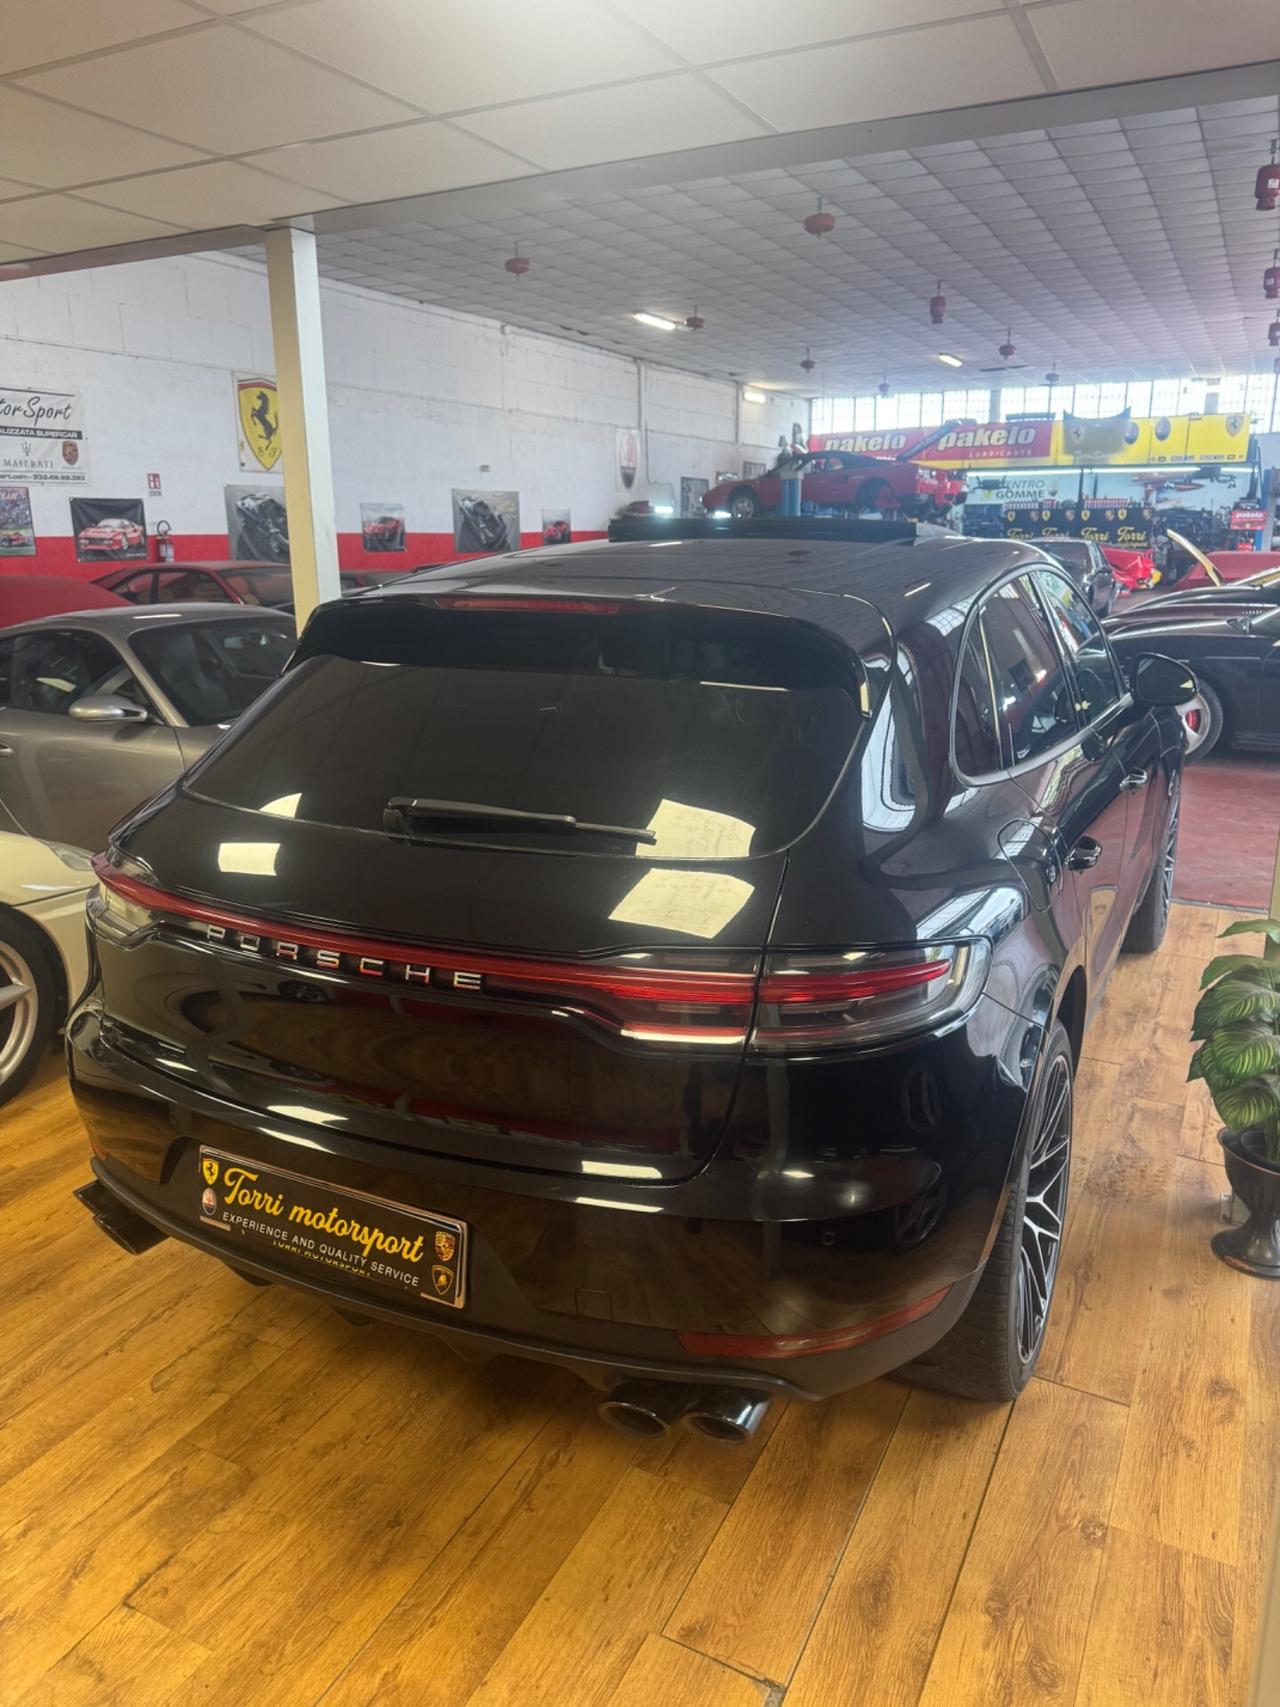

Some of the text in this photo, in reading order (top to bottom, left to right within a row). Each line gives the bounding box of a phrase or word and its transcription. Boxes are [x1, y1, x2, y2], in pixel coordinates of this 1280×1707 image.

[36, 430, 78, 439] SUPERCAR
[937, 425, 1038, 451] pakelo
[3, 458, 54, 468] MASERATI
[1003, 478, 1046, 489] ENTRO
[995, 490, 1044, 500] GOMME
[1081, 527, 1109, 541] Torri
[1117, 526, 1147, 542] Torri
[206, 923, 482, 990] PORSCHE
[223, 1167, 424, 1263] Torri motorsport
[222, 1211, 420, 1288] EXPERIENCE AND QUALITY SERVICE
